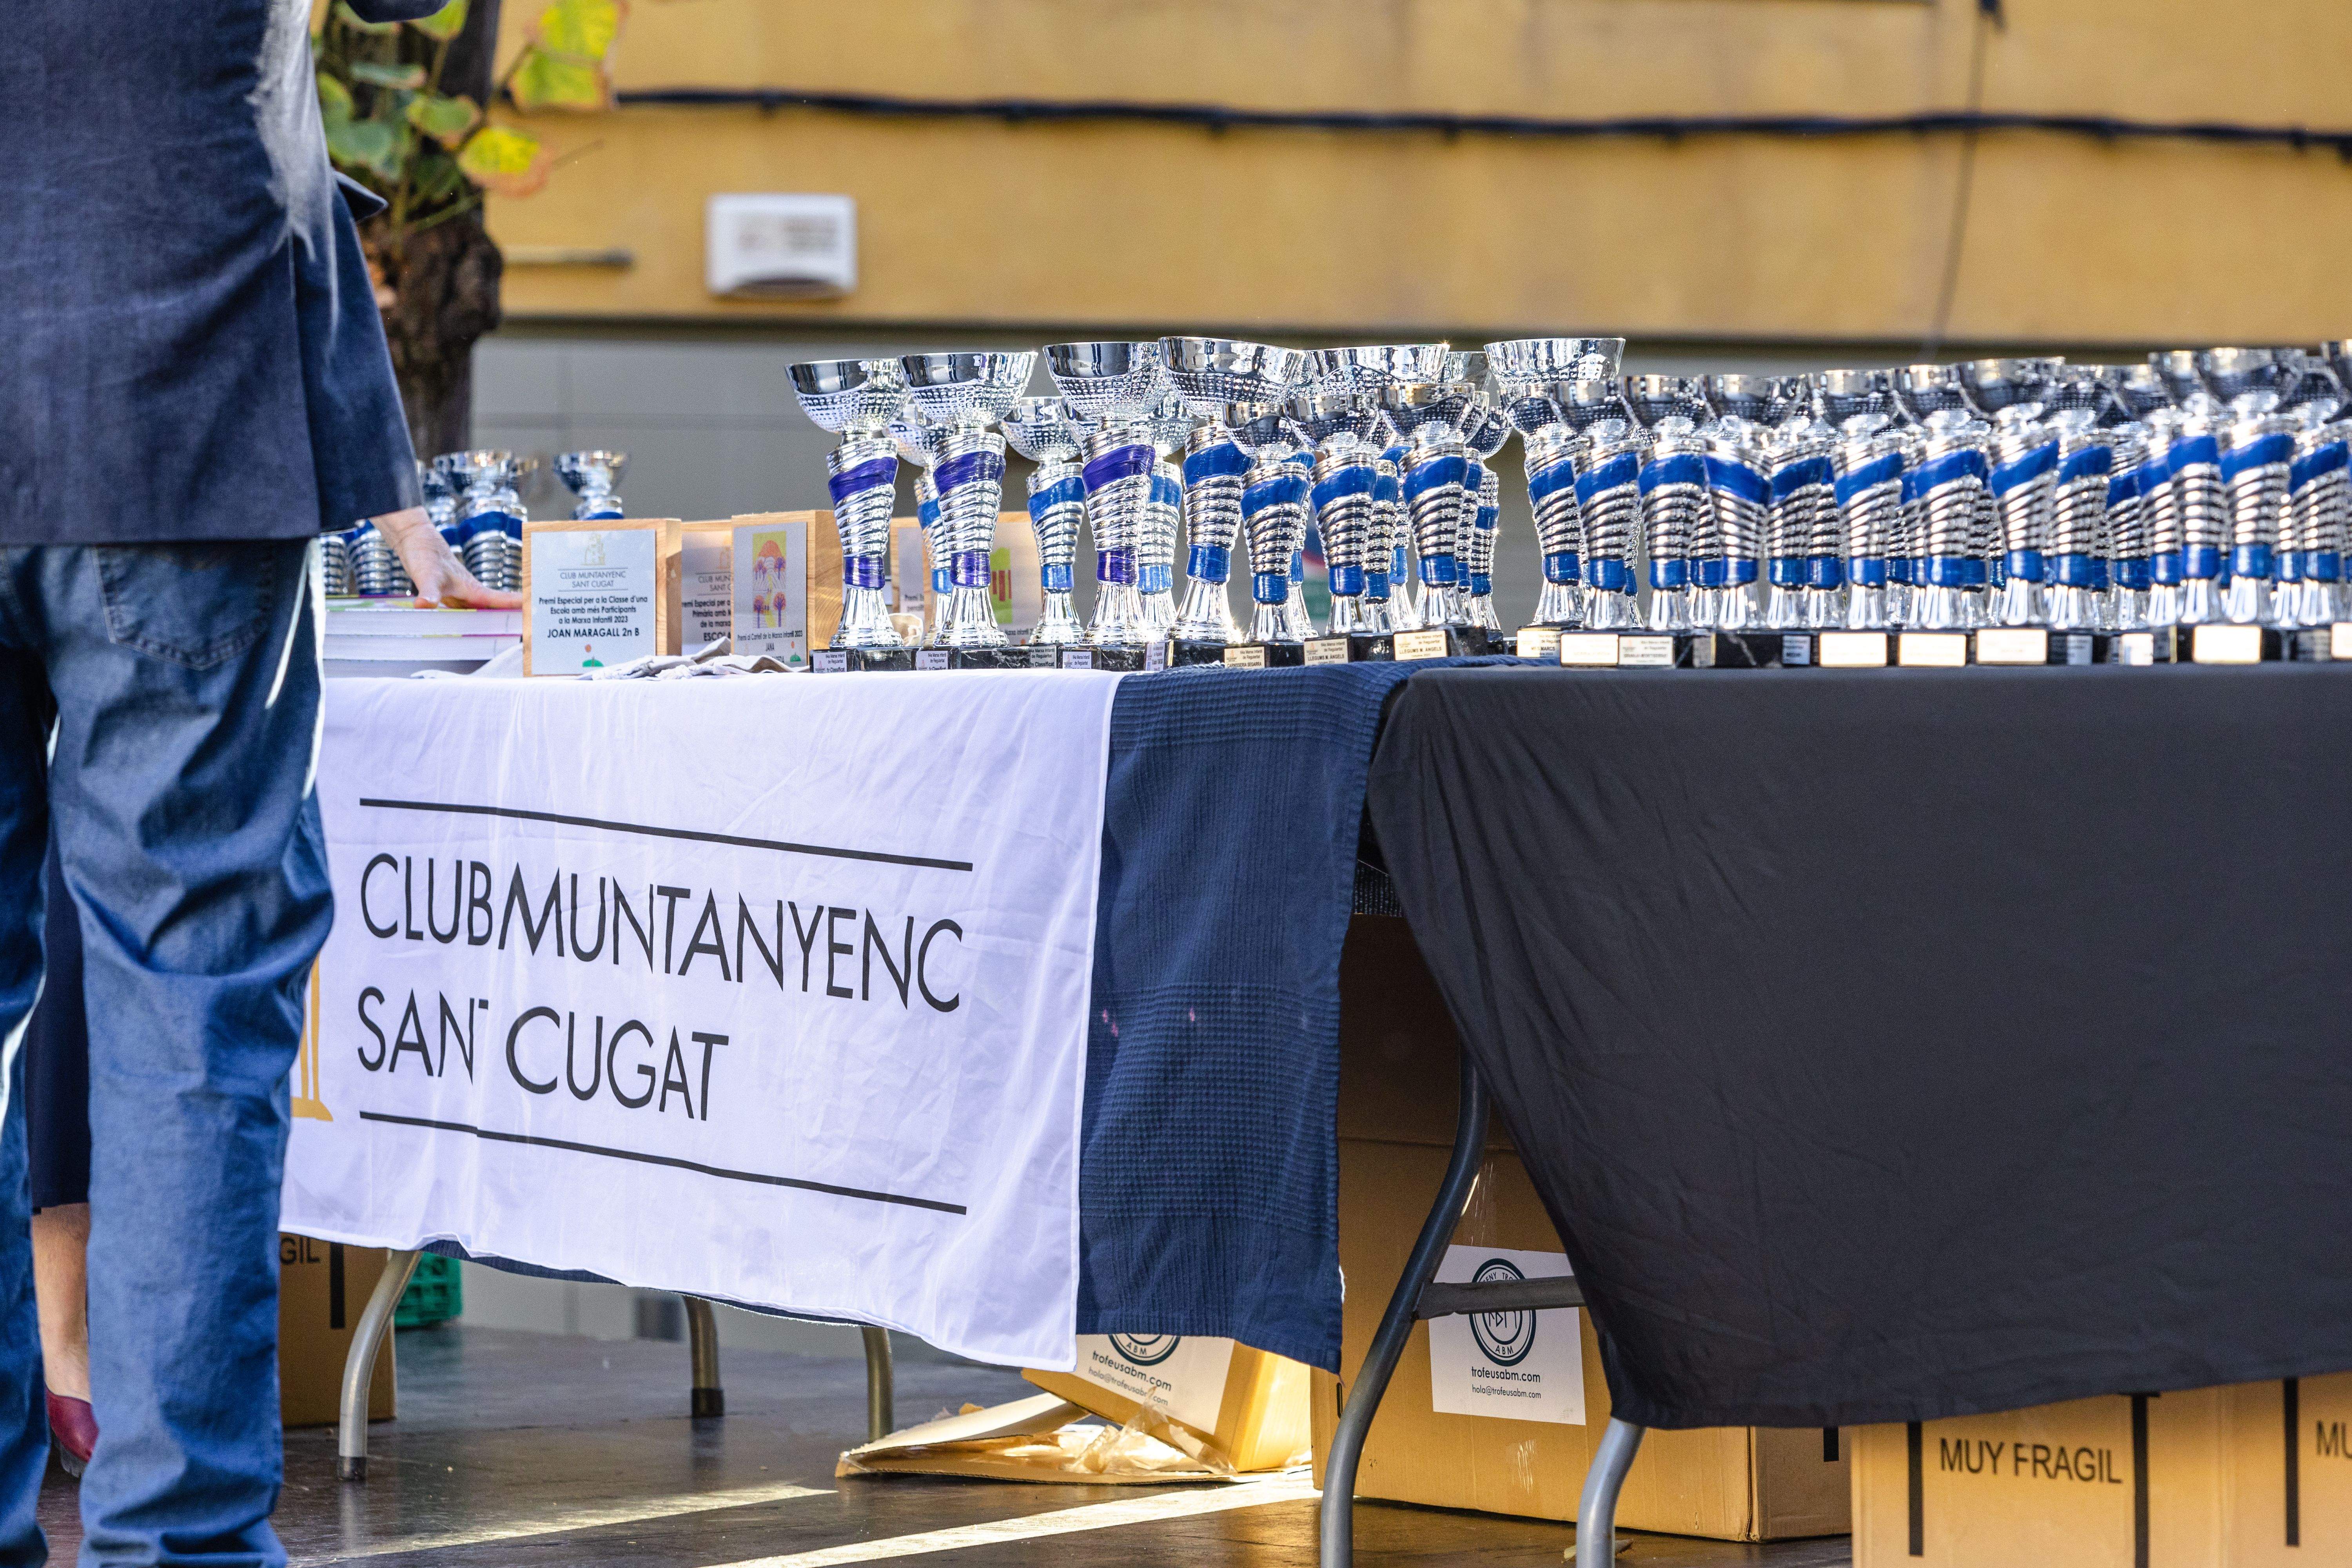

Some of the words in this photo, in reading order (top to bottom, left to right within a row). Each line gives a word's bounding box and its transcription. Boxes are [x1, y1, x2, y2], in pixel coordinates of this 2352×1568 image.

[557, 597, 582, 605] Especial
[695, 599, 715, 608] Especial
[601, 605, 636, 615] Participants
[548, 628, 570, 638] JOAN
[573, 628, 620, 637] MARAGALL
[622, 627, 632, 637] 2n
[635, 627, 639, 636] B
[765, 643, 775, 652] JANA
[361, 852, 492, 946] CLUB
[498, 862, 963, 1013] MUNTANYENC
[505, 1006, 729, 1121] CUGAT
[1126, 1341, 1147, 1355] ABM
[1495, 1345, 1514, 1355] ABM
[1093, 1350, 1171, 1392] trofeusabm.com
[1471, 1367, 1541, 1383] trofeusabm.com
[1472, 1384, 1541, 1399] hola@trofeusabm.com
[1940, 1438, 2005, 1475] MUY
[2014, 1443, 2122, 1484] FRAGIL
